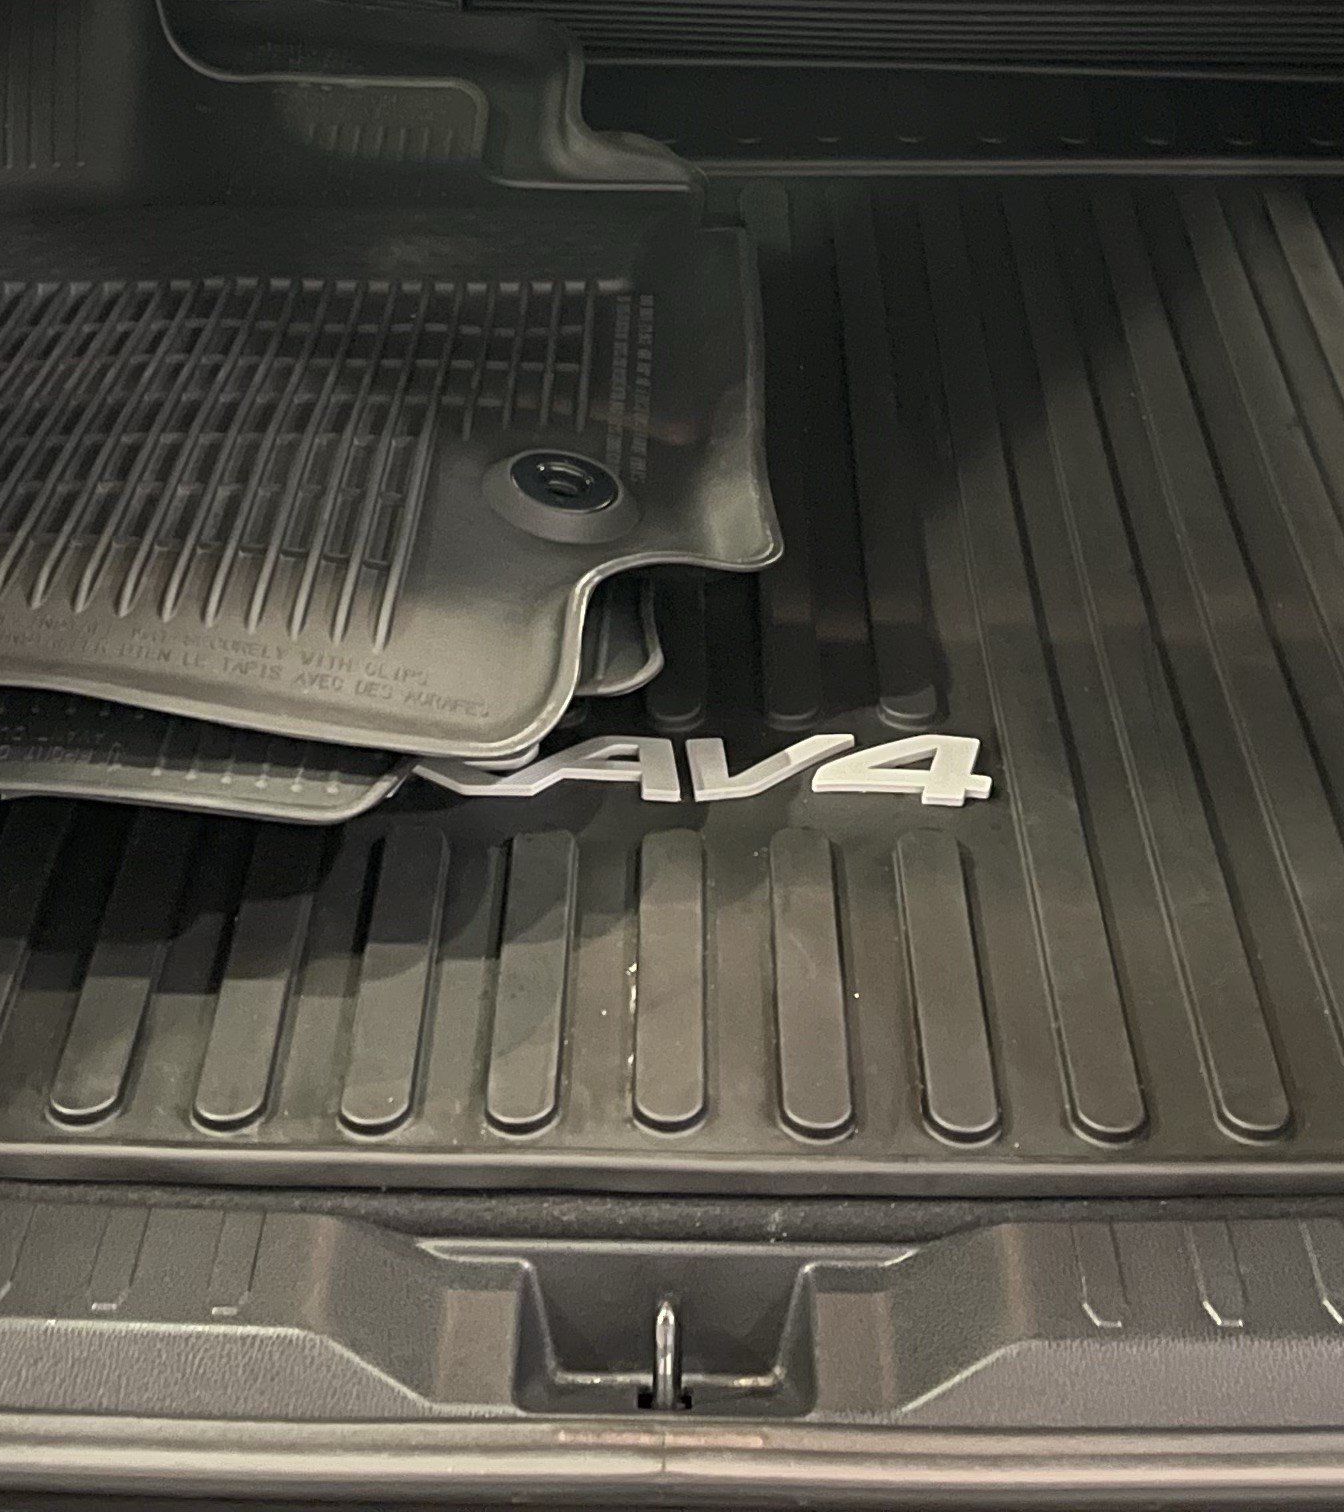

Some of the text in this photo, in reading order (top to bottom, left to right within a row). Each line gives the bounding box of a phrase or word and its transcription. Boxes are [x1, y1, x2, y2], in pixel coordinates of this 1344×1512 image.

[222, 656, 284, 682] TAPIS
[294, 671, 346, 692] AVEC
[300, 648, 353, 674] WITH
[364, 660, 429, 687] CLIPS
